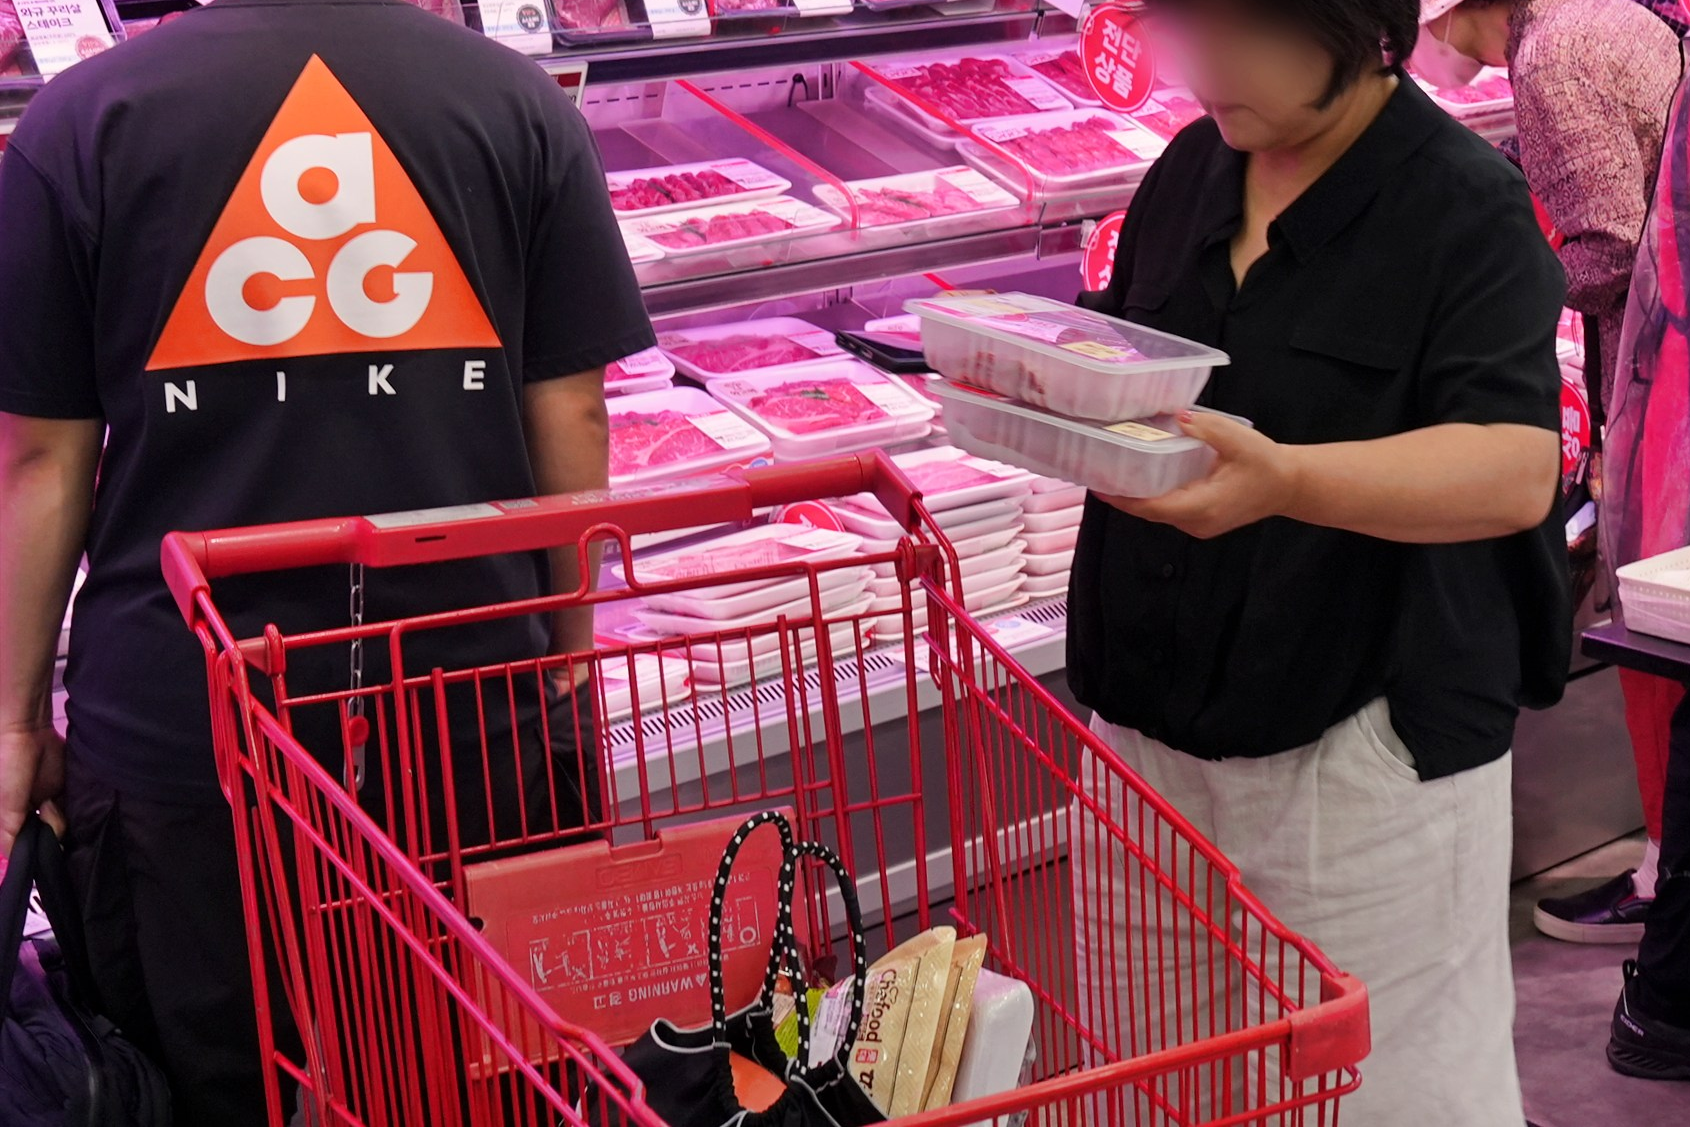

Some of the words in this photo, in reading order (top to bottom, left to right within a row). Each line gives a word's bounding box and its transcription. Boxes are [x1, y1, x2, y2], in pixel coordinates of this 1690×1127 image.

[20, 6, 44, 18] 와규
[47, 3, 82, 15] 꾸리살
[27, 17, 74, 31] 스테이크
[1102, 18, 1142, 69] 전단
[1093, 51, 1133, 100] 상품
[163, 359, 488, 414] NIKE
[627, 975, 694, 1004] WARNING
